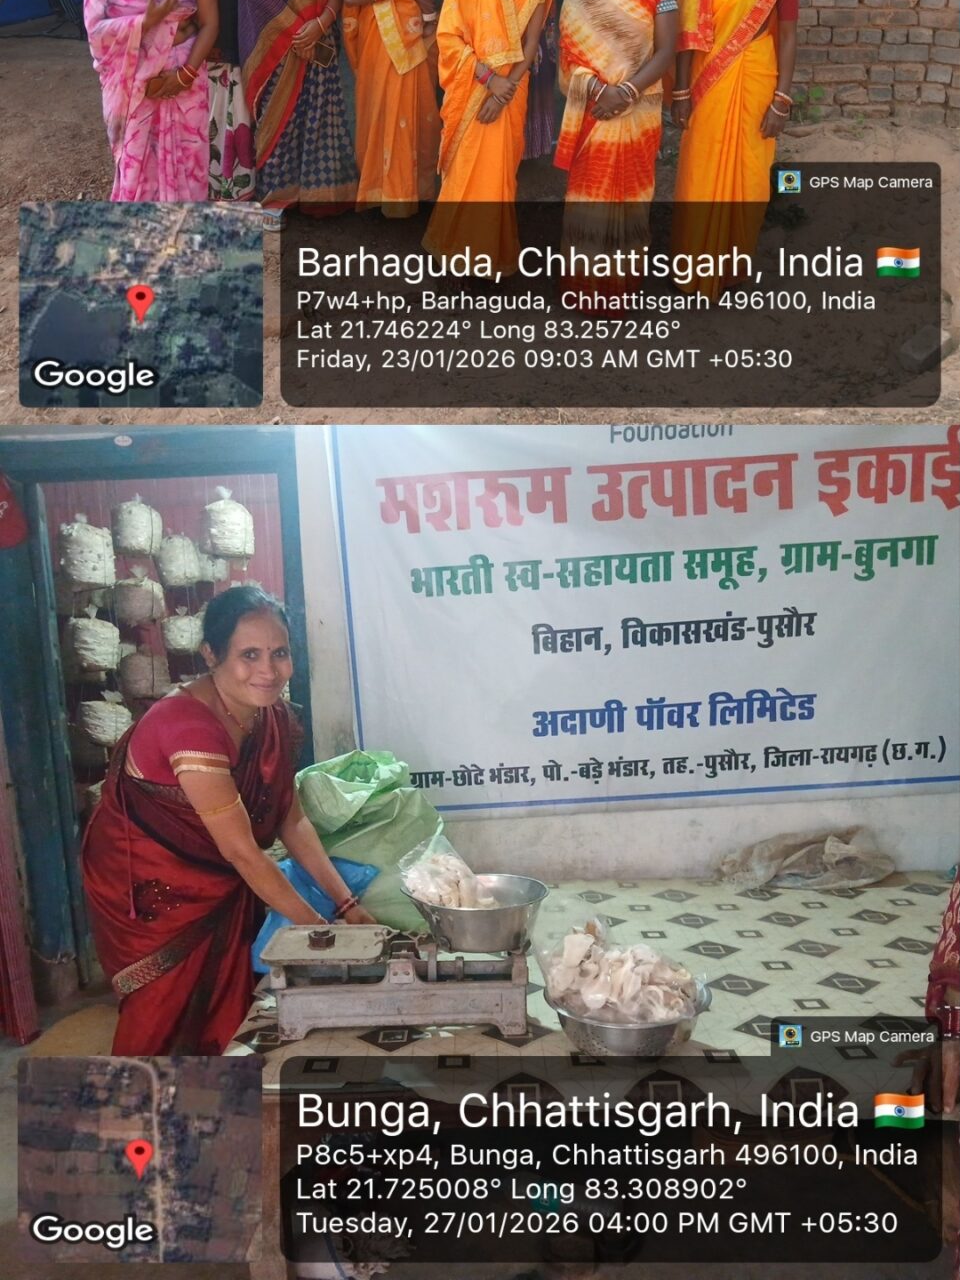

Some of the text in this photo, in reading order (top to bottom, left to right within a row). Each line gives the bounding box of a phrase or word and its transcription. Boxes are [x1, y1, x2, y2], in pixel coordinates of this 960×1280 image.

[376, 424, 960, 534] मशरूम उत्पादन इकाई
[410, 535, 939, 597] भारती स्व-सहायता समूह, ग्राम-बुनगा
[532, 606, 818, 655] बिहान, विकासखंड-पुसौर
[532, 687, 818, 737] अदाणी पॉवर लिमिटेड
[410, 763, 485, 789] ग्राम-छोटे
[489, 762, 537, 787] भंडार,
[542, 757, 604, 785] पो.-बड़े
[607, 756, 656, 780] भंडार,
[764, 745, 878, 768] जिला-रायगढ़
[882, 735, 947, 766] (छ.ग.)
